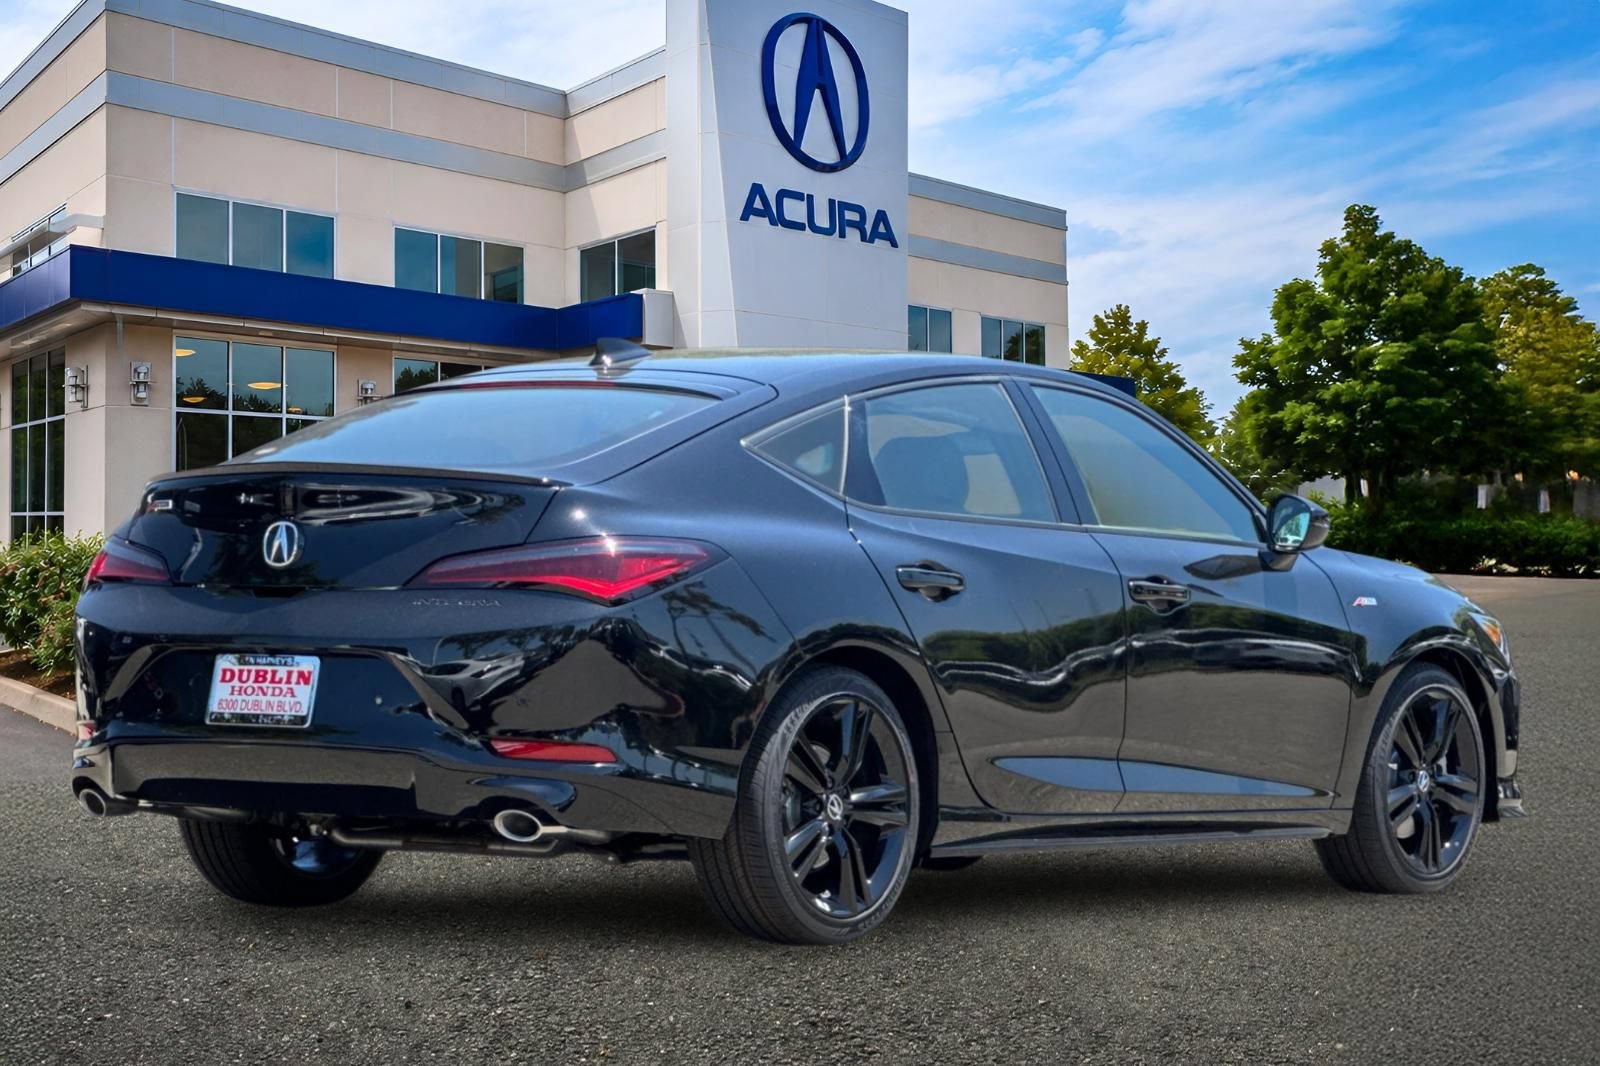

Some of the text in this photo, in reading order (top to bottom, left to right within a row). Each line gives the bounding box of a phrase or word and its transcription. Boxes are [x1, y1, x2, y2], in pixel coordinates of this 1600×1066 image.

[740, 182, 898, 248] ACURA
[219, 667, 313, 686] DUBLIN
[229, 685, 297, 698] HONDA
[217, 698, 239, 711] 6300
[240, 699, 275, 713] DUBLIN
